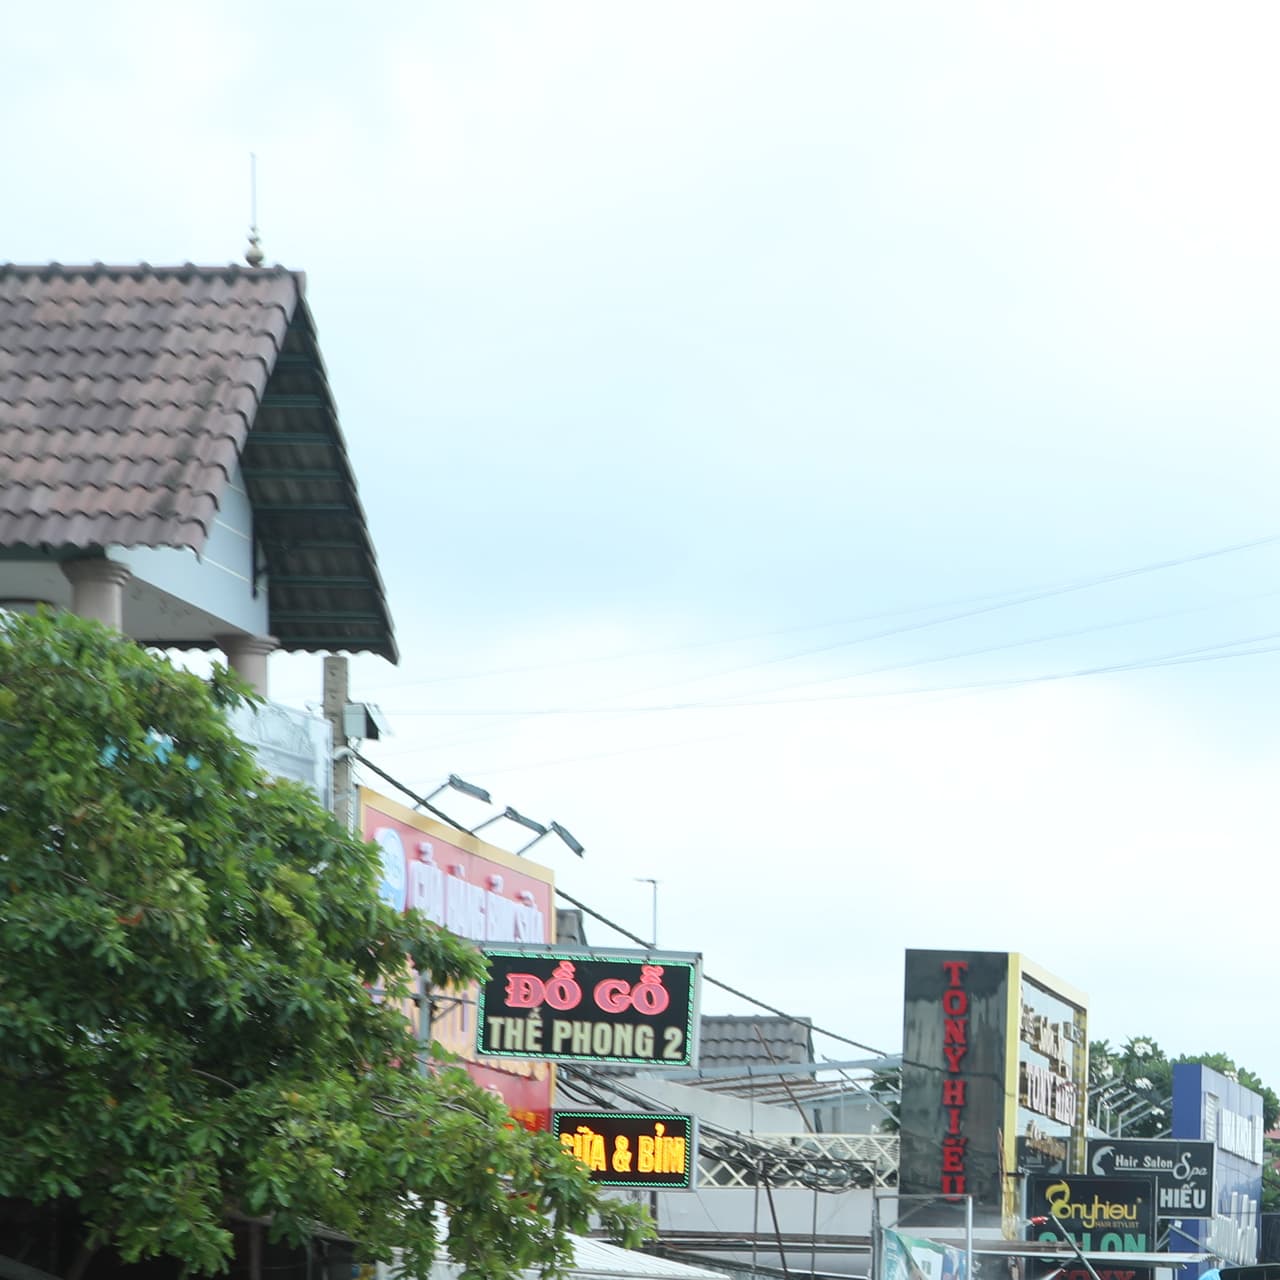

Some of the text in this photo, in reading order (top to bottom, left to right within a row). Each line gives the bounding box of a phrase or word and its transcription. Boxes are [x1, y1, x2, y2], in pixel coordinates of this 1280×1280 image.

[504, 960, 583, 1011] ĐỒ
[593, 965, 670, 1015] GỖ
[487, 1007, 543, 1051] THẾ
[552, 1019, 655, 1057] PHONG
[663, 1027, 683, 1059] 2
[943, 961, 968, 1073] TONY
[612, 1135, 632, 1172] &
[1115, 1152, 1207, 1180] Hair Salon Spa
[1160, 1182, 1206, 1209] HIẾU
